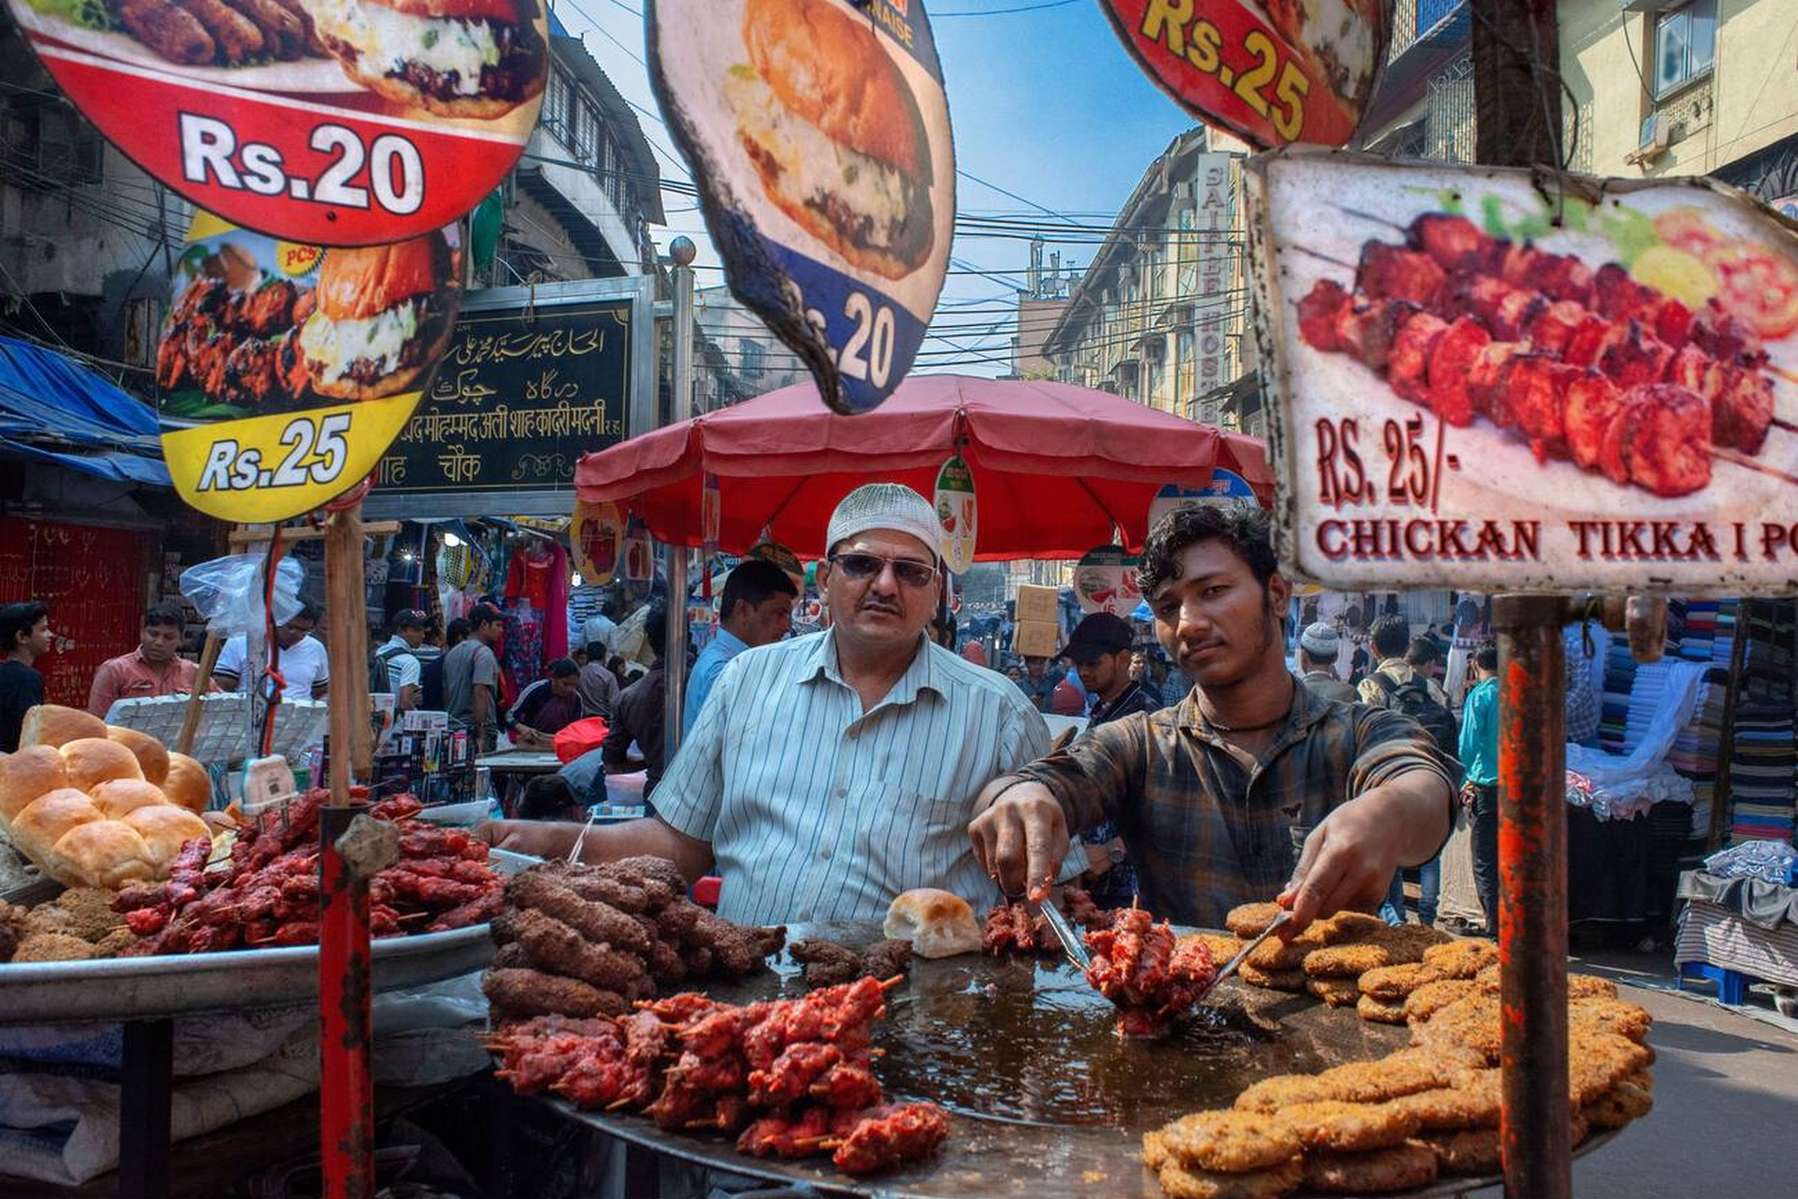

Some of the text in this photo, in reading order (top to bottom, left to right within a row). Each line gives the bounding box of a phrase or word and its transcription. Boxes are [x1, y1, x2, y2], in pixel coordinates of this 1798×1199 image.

[1140, 0, 1309, 141] Rs.25
[178, 111, 425, 216] Rs.20
[1202, 167, 1226, 297] SAIFEE
[424, 406, 479, 443] मोहम्मद
[479, 404, 508, 439] अली
[510, 410, 534, 438] शाह
[536, 400, 571, 436] कादरी
[570, 398, 606, 436] मदनी
[431, 368, 497, 405] چوک
[196, 412, 352, 492] Rs.25
[437, 444, 482, 482] चौक
[1316, 412, 1461, 516] RS. 25/-
[1316, 519, 1541, 562] CHICKAN
[1567, 520, 1721, 562] TIKKA
